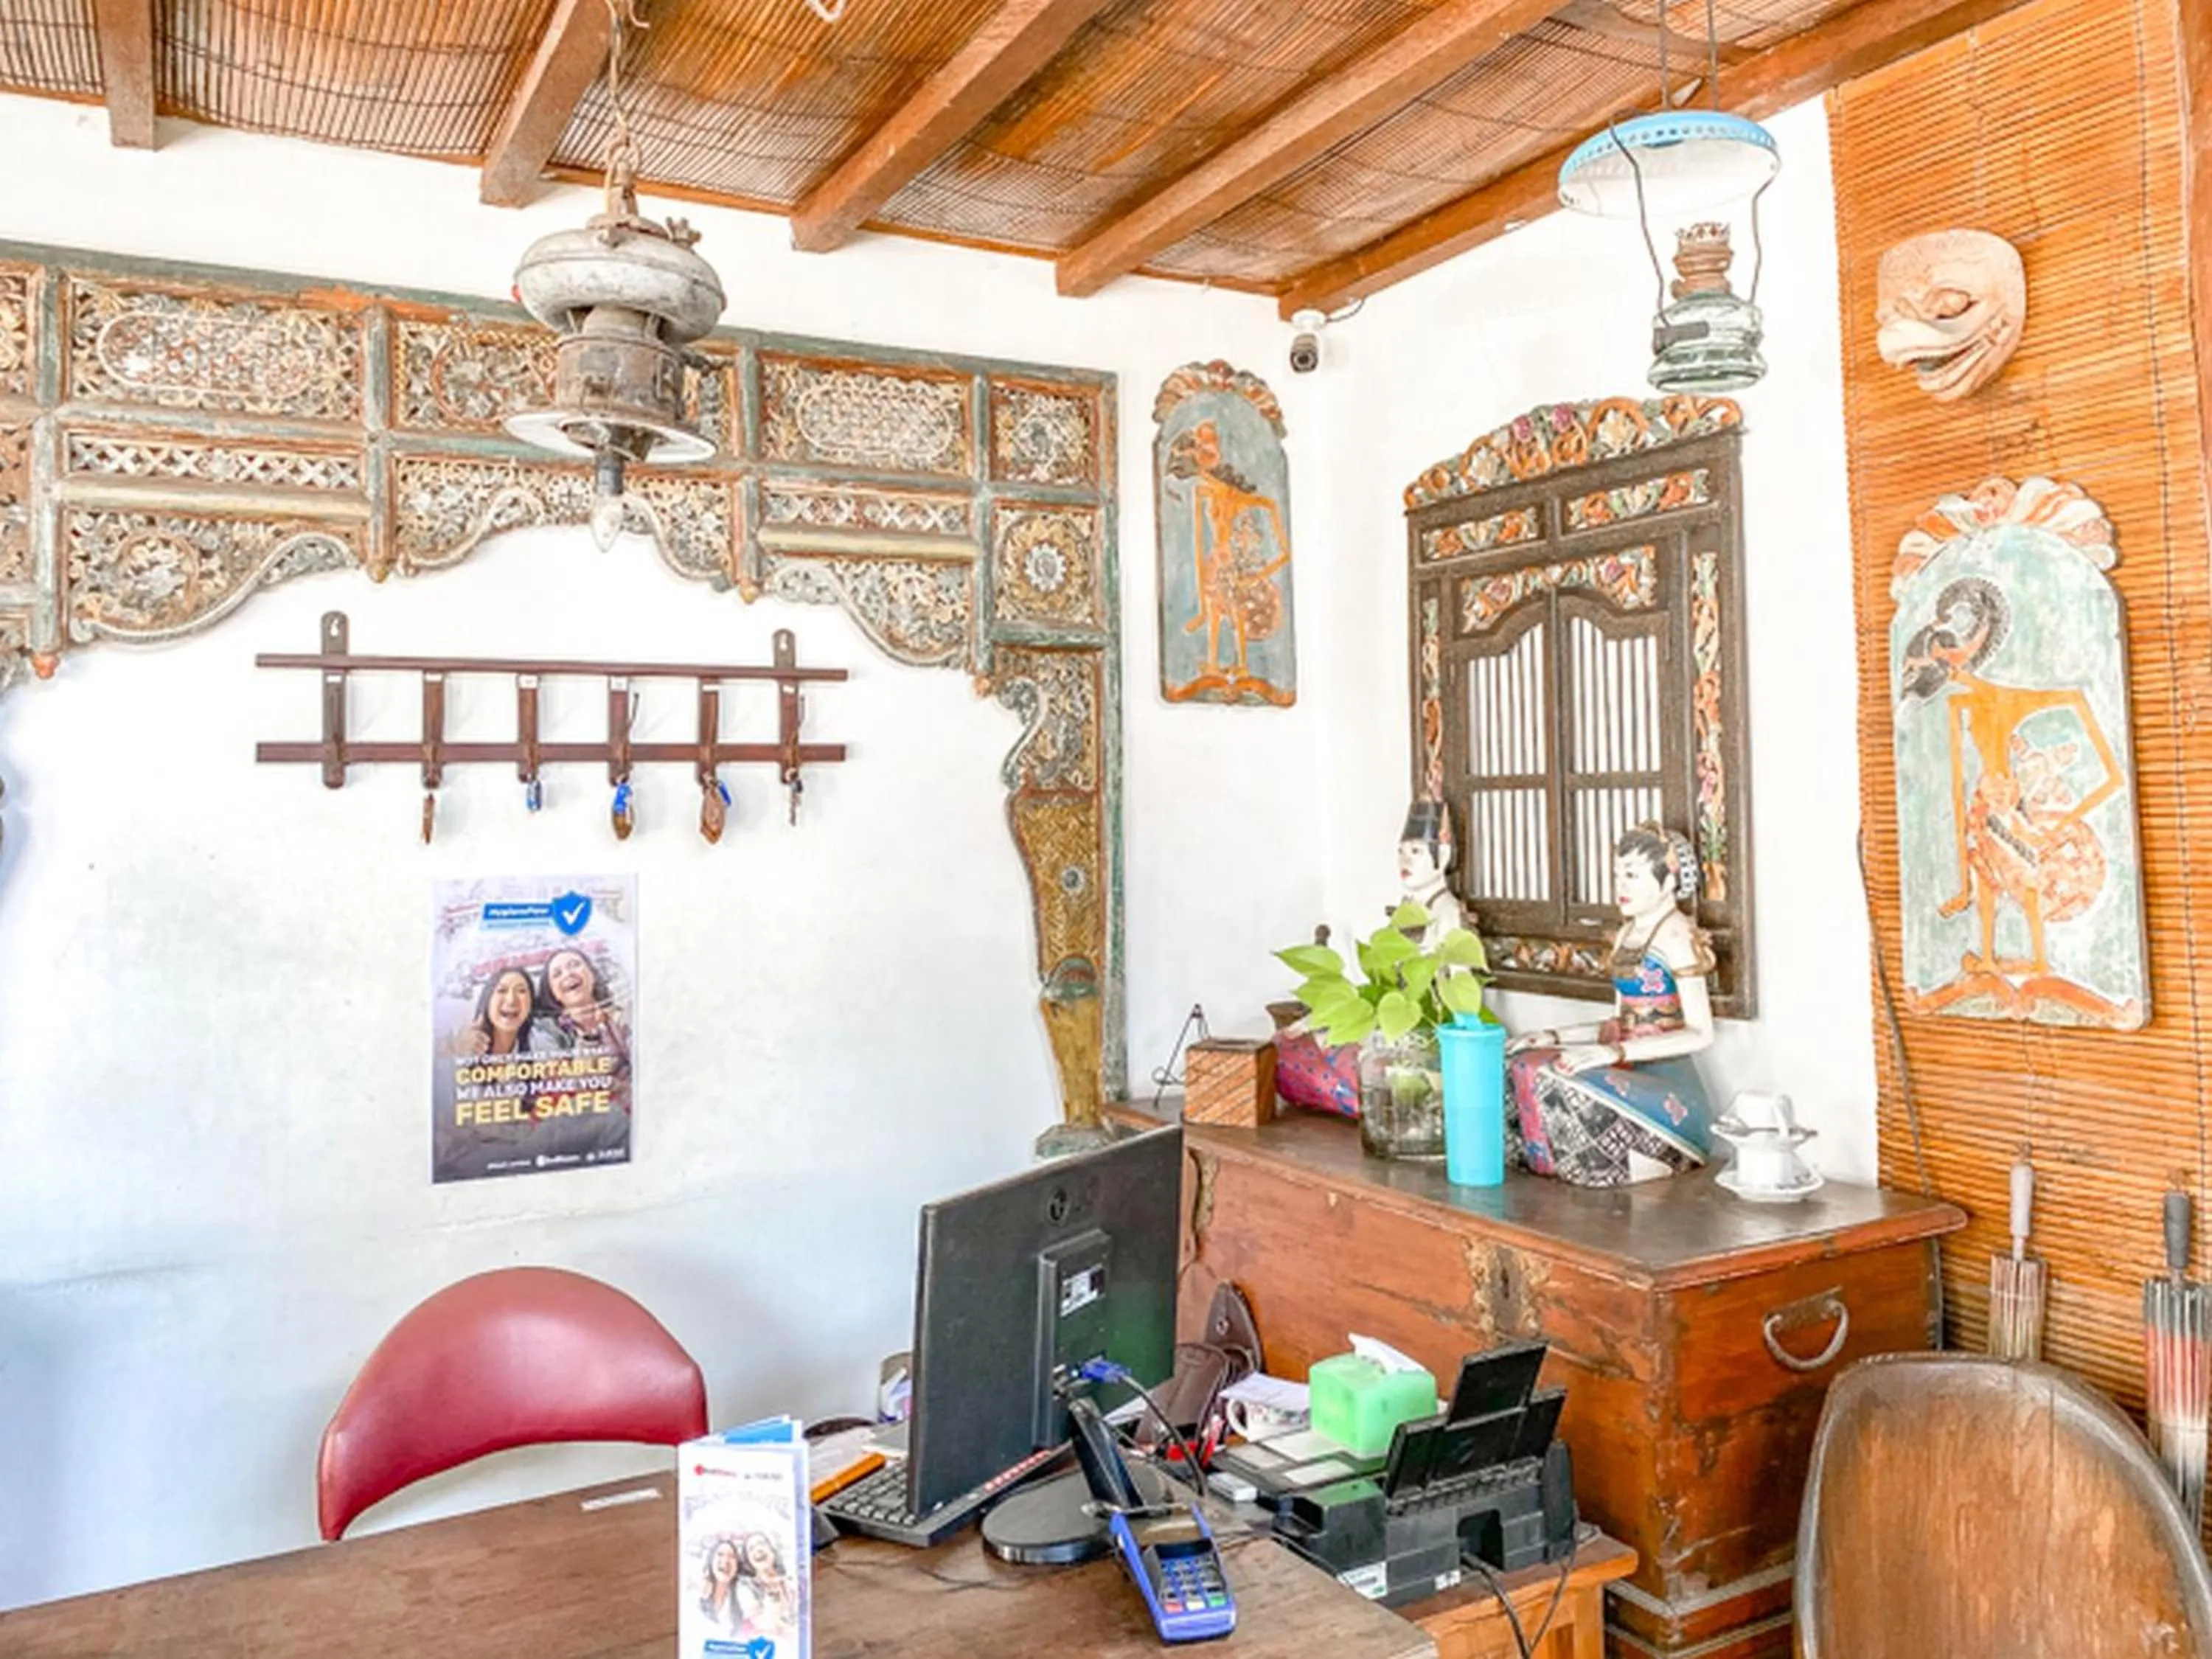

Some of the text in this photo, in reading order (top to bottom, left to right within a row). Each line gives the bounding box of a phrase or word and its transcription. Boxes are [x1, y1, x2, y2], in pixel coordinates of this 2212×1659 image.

[455, 1058, 611, 1085] COMFORTABLE
[483, 1082, 528, 1098] ALSO
[530, 1079, 574, 1094] MAKE
[579, 1076, 613, 1089] YOU
[455, 1092, 611, 1126] FEEL SAFE
